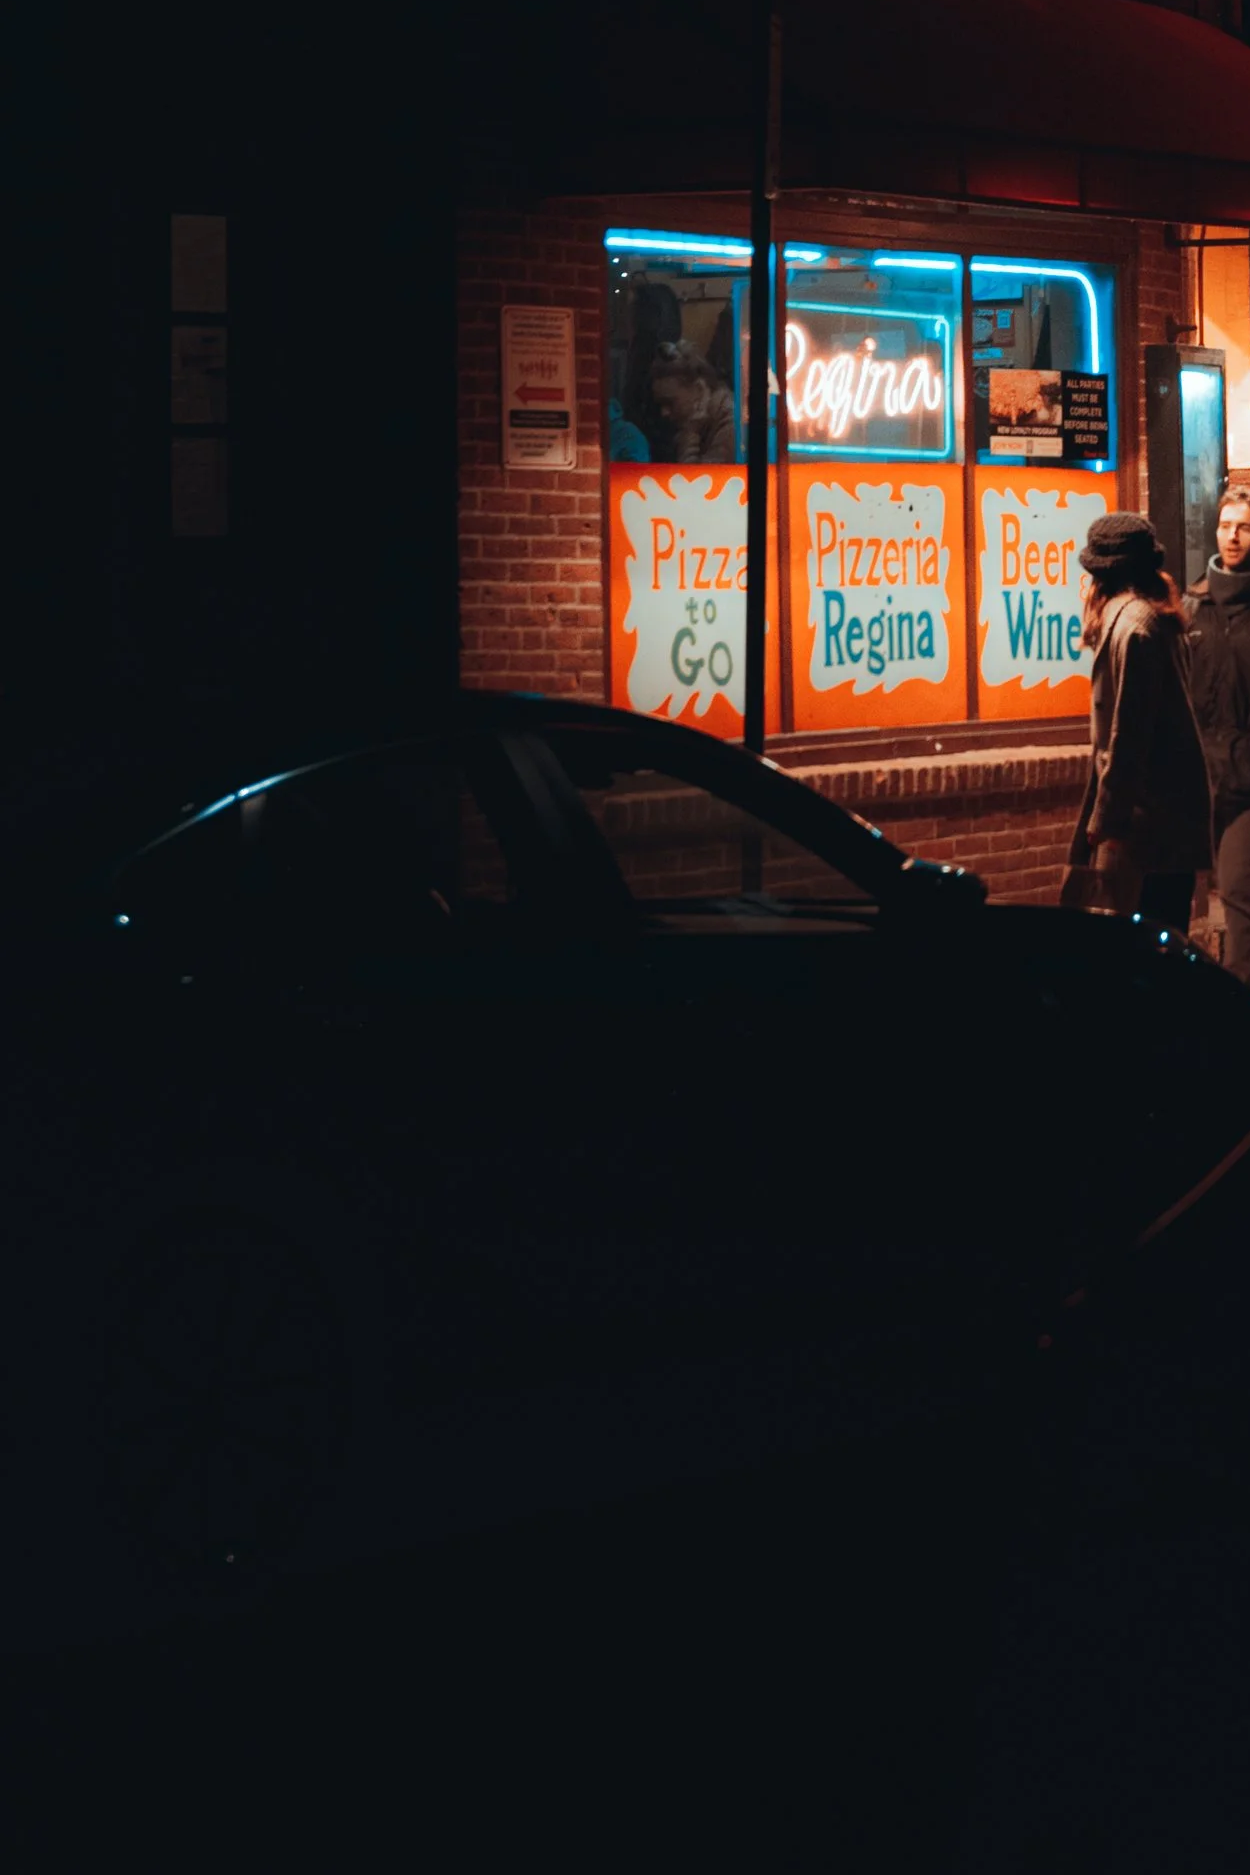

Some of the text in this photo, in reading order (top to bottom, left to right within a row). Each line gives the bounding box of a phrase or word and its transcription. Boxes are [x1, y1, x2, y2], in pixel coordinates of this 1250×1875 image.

[816, 512, 940, 587] Pizzeria
[1001, 513, 1076, 586] Beer
[685, 597, 717, 624] to
[823, 590, 935, 676] Regina
[1002, 590, 1082, 662] Wine
